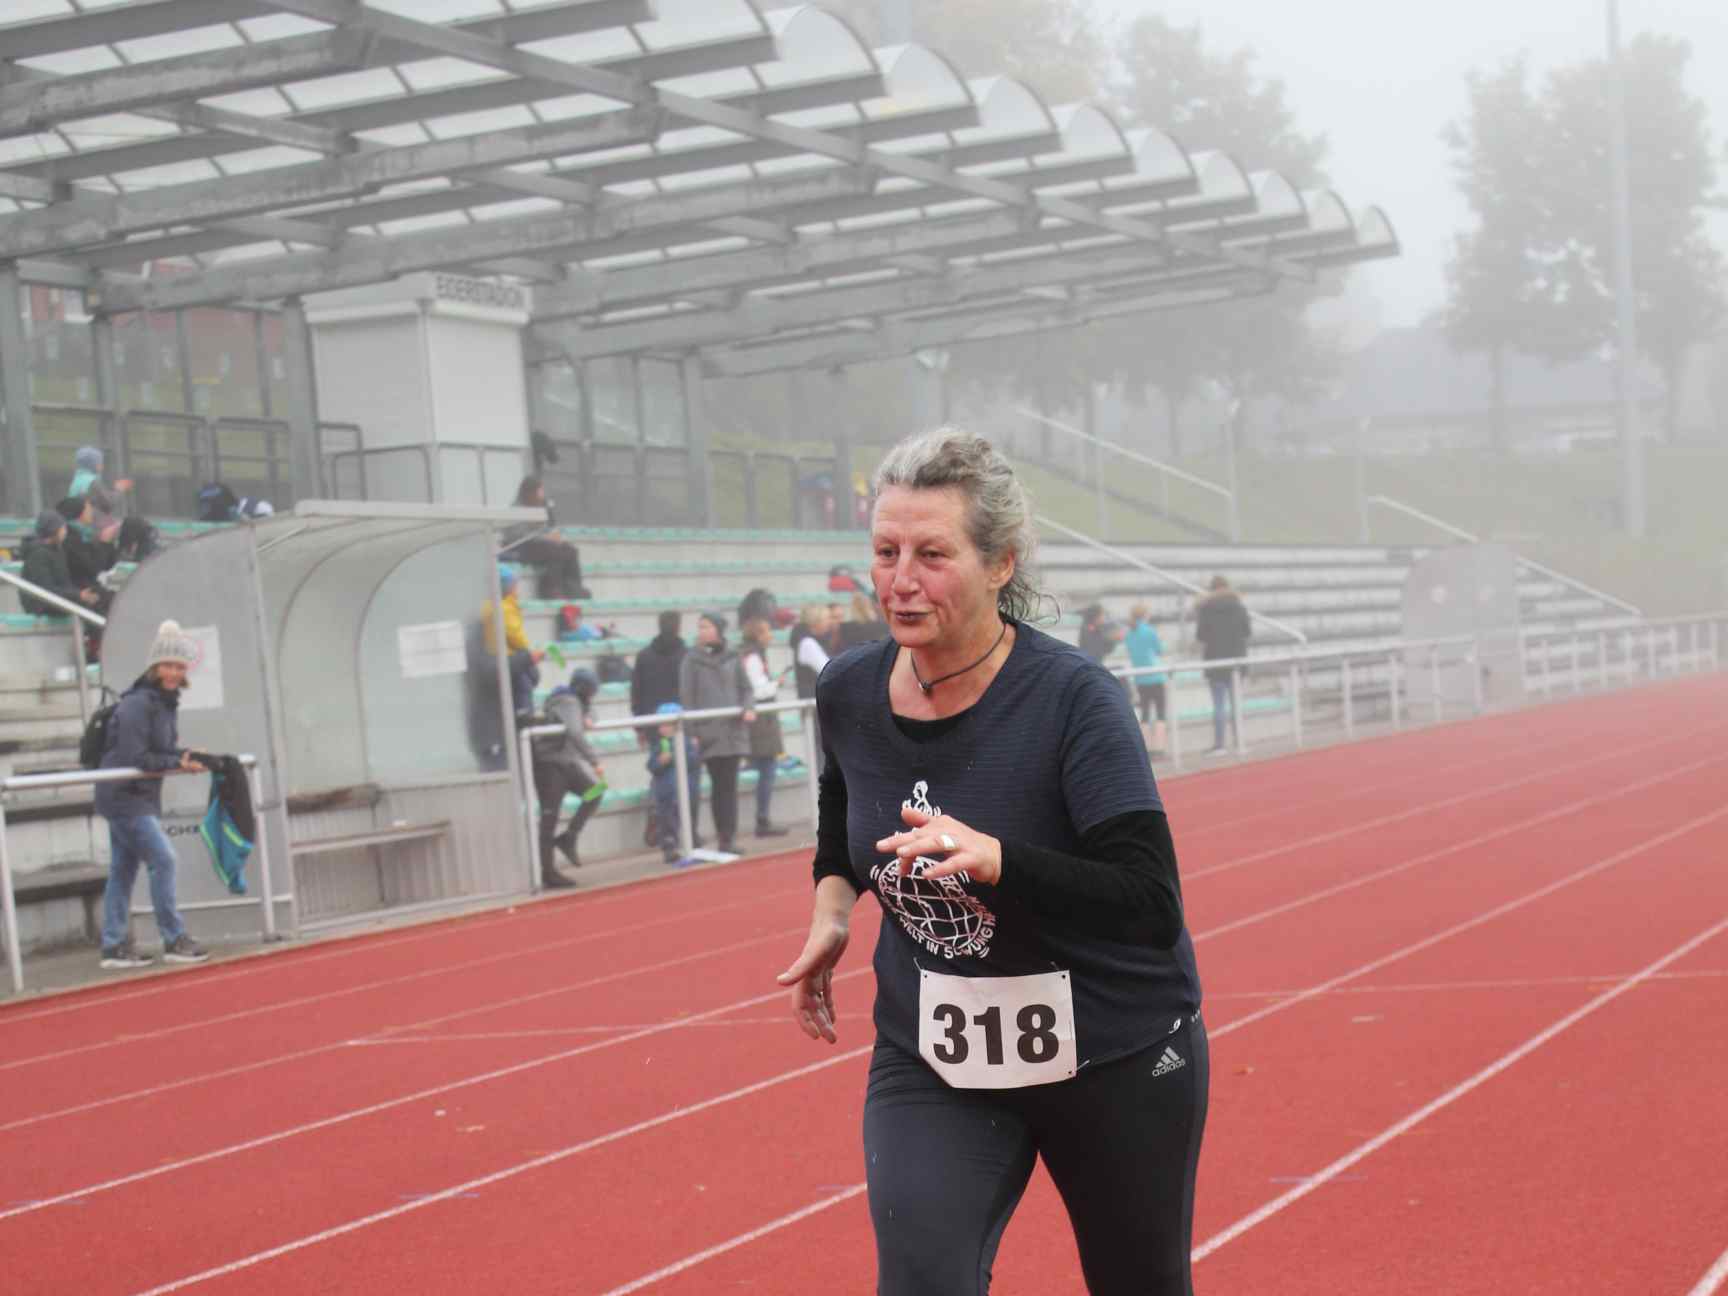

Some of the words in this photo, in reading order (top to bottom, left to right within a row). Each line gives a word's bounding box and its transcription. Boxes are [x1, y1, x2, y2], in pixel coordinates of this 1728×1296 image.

[925, 941, 940, 956] IN
[932, 1003, 1060, 1066] 318
[1151, 1058, 1187, 1078] adidas
